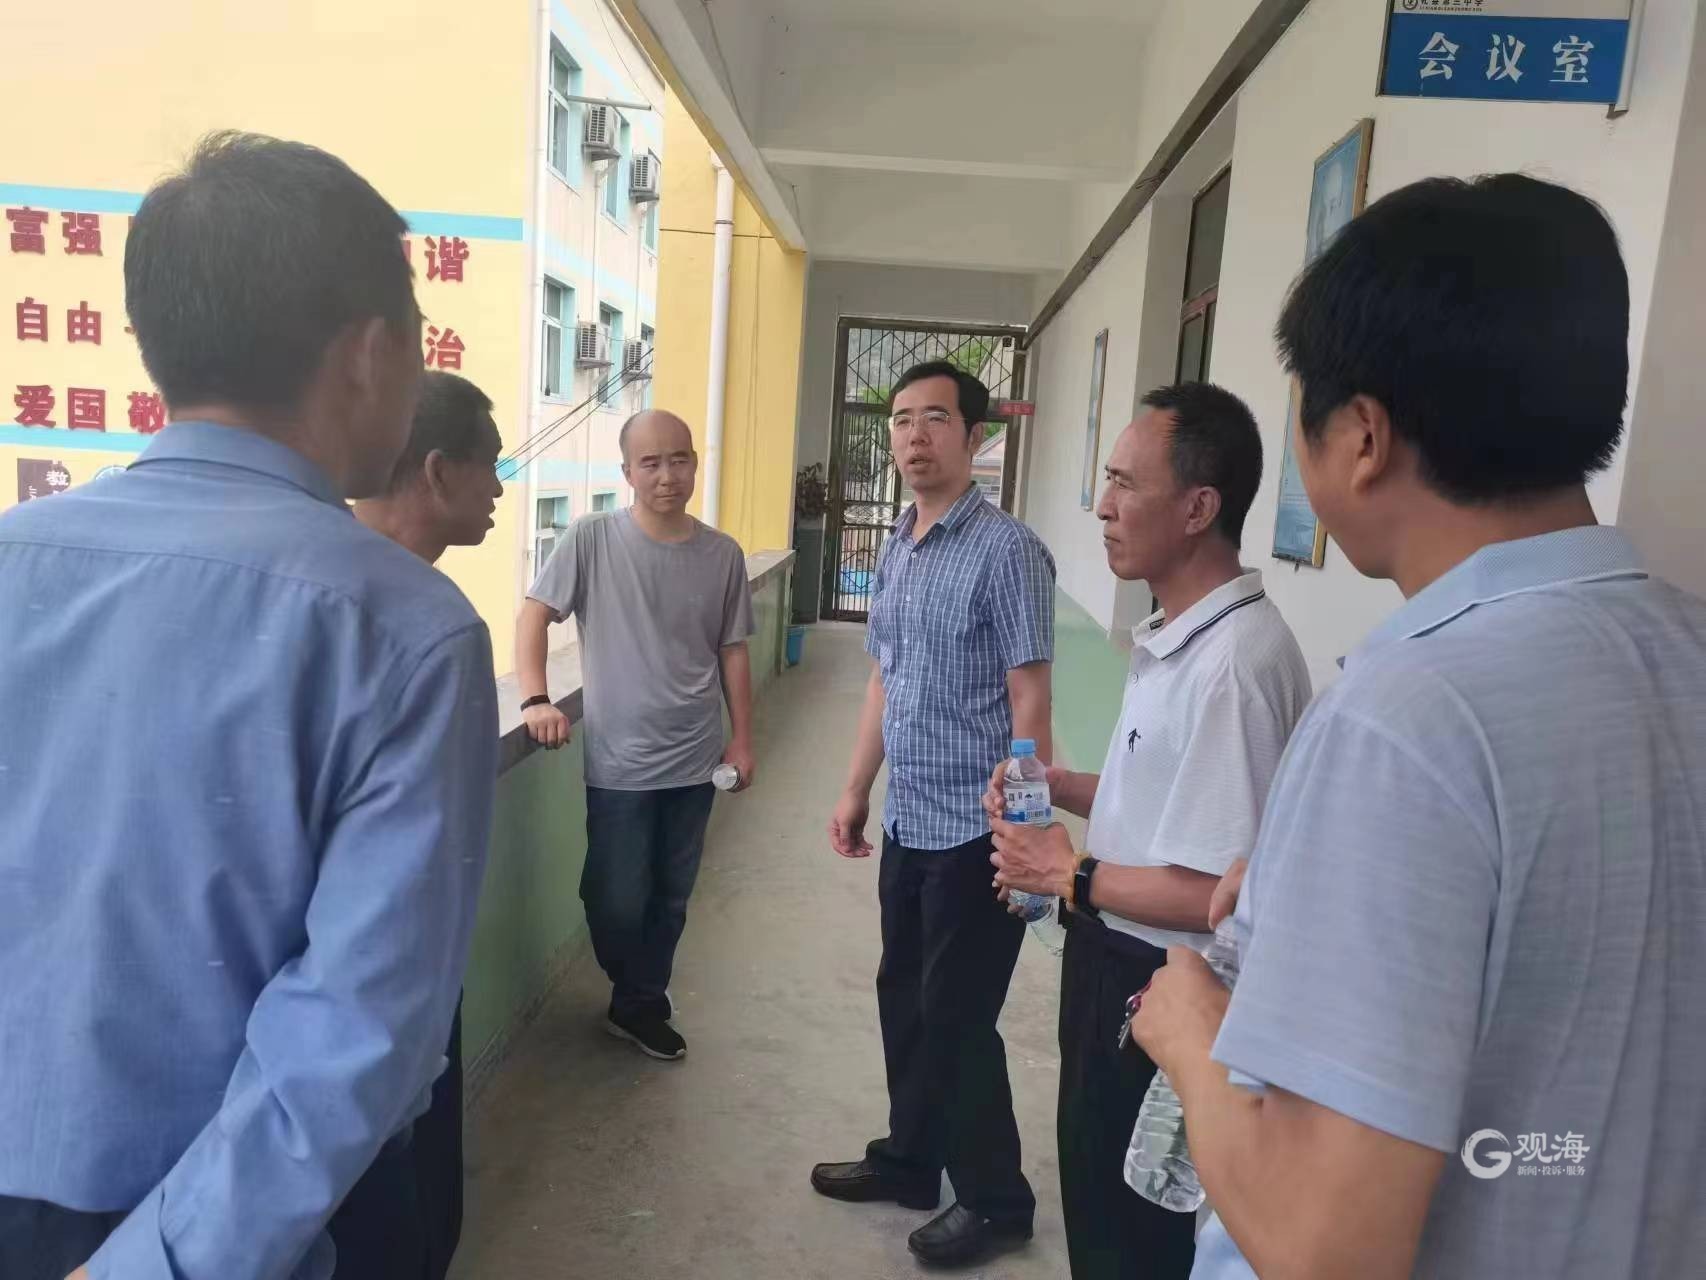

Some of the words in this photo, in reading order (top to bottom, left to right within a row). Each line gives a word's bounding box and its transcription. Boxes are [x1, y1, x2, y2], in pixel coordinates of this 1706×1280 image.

[1418, 31, 1595, 84] 会议室
[6, 206, 103, 256] 富强
[402, 236, 470, 283] 谐
[16, 297, 102, 345] 自由
[425, 325, 466, 371] 治
[14, 384, 106, 433] 爱国
